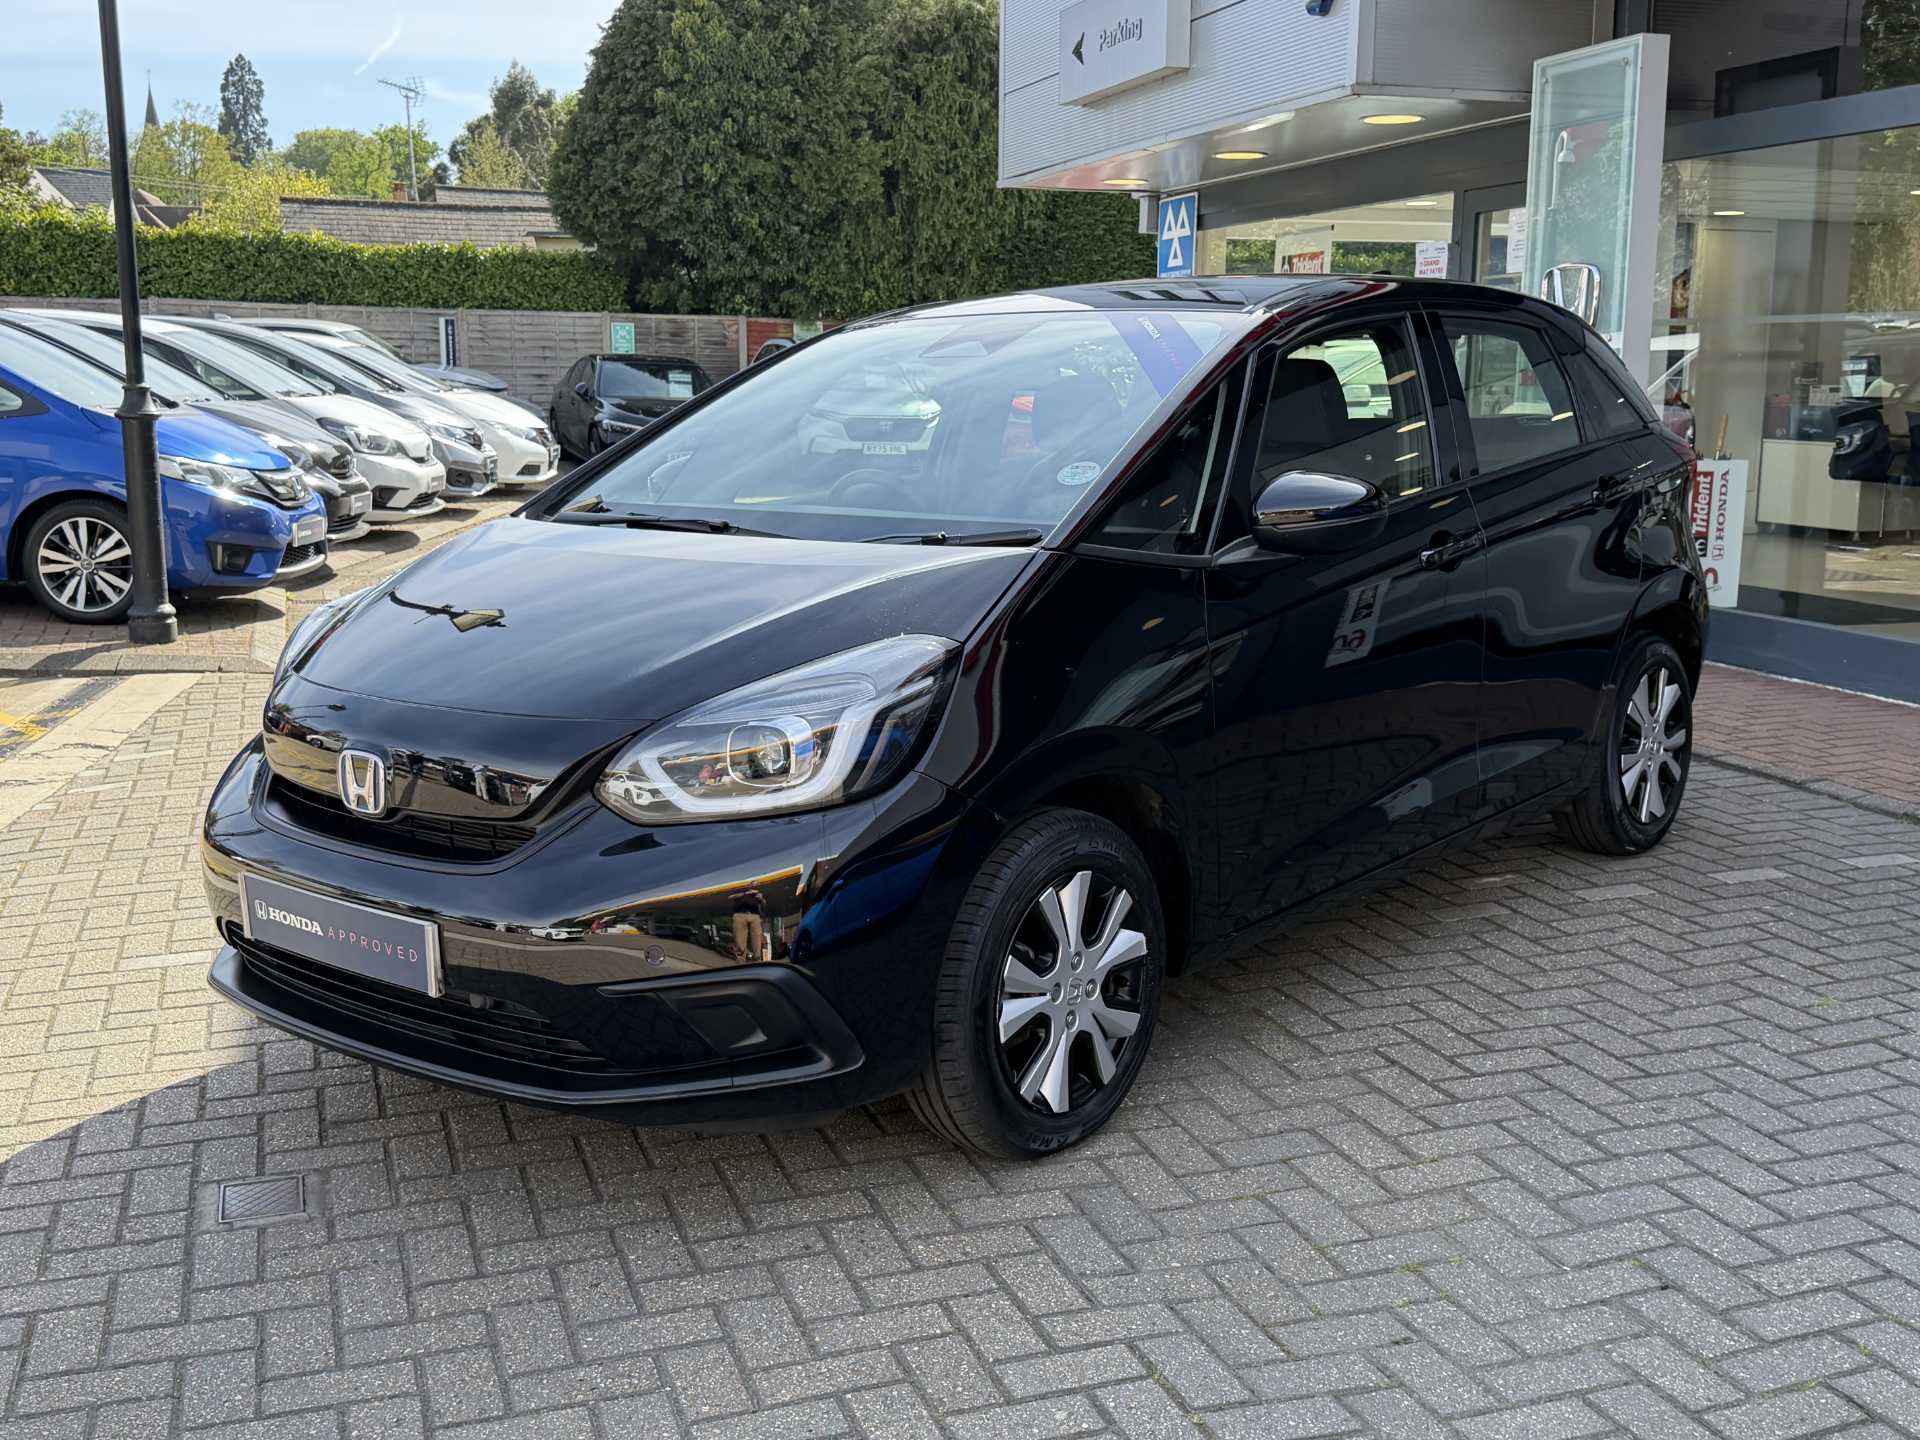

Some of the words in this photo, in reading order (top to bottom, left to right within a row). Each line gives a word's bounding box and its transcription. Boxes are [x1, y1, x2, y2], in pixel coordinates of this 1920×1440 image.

[1099, 17, 1143, 51] Parking
[1692, 475, 1711, 535] Trident
[1715, 468, 1730, 541] HONDA
[269, 907, 324, 937] HONDA
[327, 927, 418, 962] APPROVED
